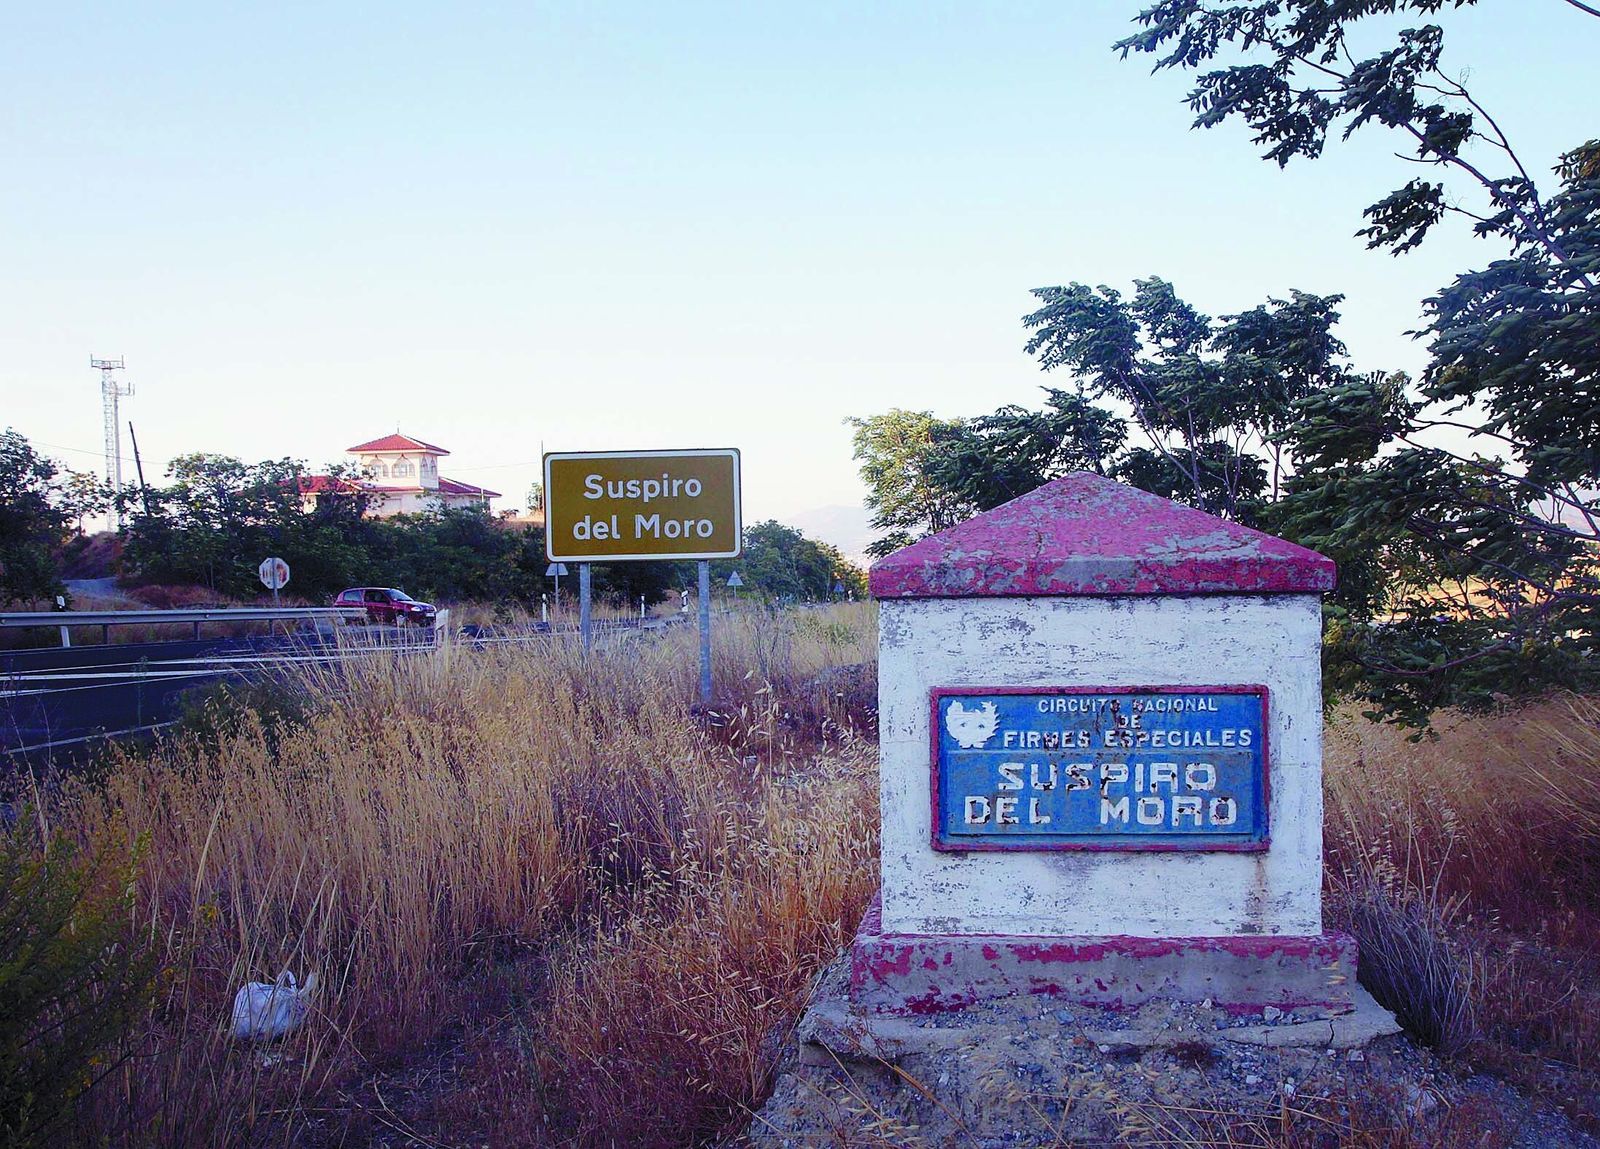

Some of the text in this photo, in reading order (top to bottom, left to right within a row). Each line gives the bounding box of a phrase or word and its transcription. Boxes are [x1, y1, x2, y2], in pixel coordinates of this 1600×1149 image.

[583, 473, 702, 503] Suspiro
[573, 514, 714, 540] del Moro
[1038, 698, 1121, 712] CIRCUITO
[1117, 714, 1141, 728] DE
[1003, 729, 1253, 749] FIRMES ESPECIALES
[998, 762, 1217, 795] SUSPIRO
[964, 796, 1237, 827] DEL MORO
